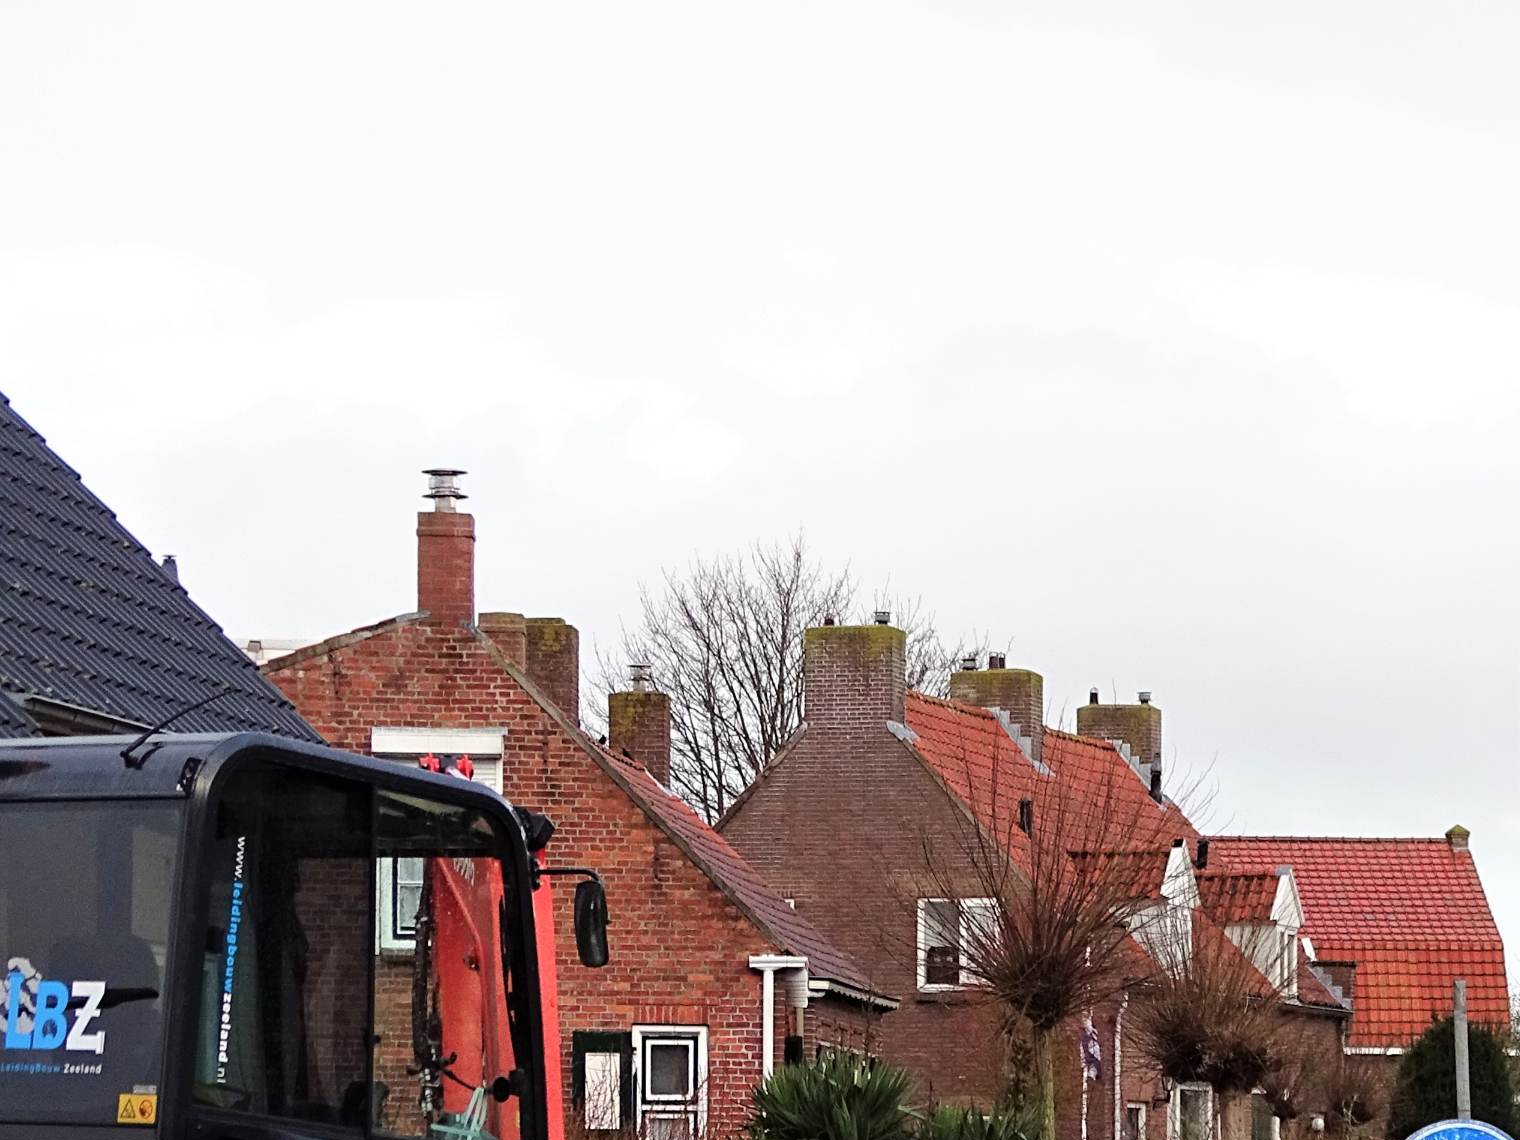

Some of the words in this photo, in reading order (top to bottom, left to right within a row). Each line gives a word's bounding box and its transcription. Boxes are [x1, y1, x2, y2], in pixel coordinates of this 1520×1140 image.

[216, 836, 246, 1084] www.leidingbouwzeeland.nl
[5, 971, 106, 1055] LBZ
[63, 1063, 103, 1075] Zeeland
